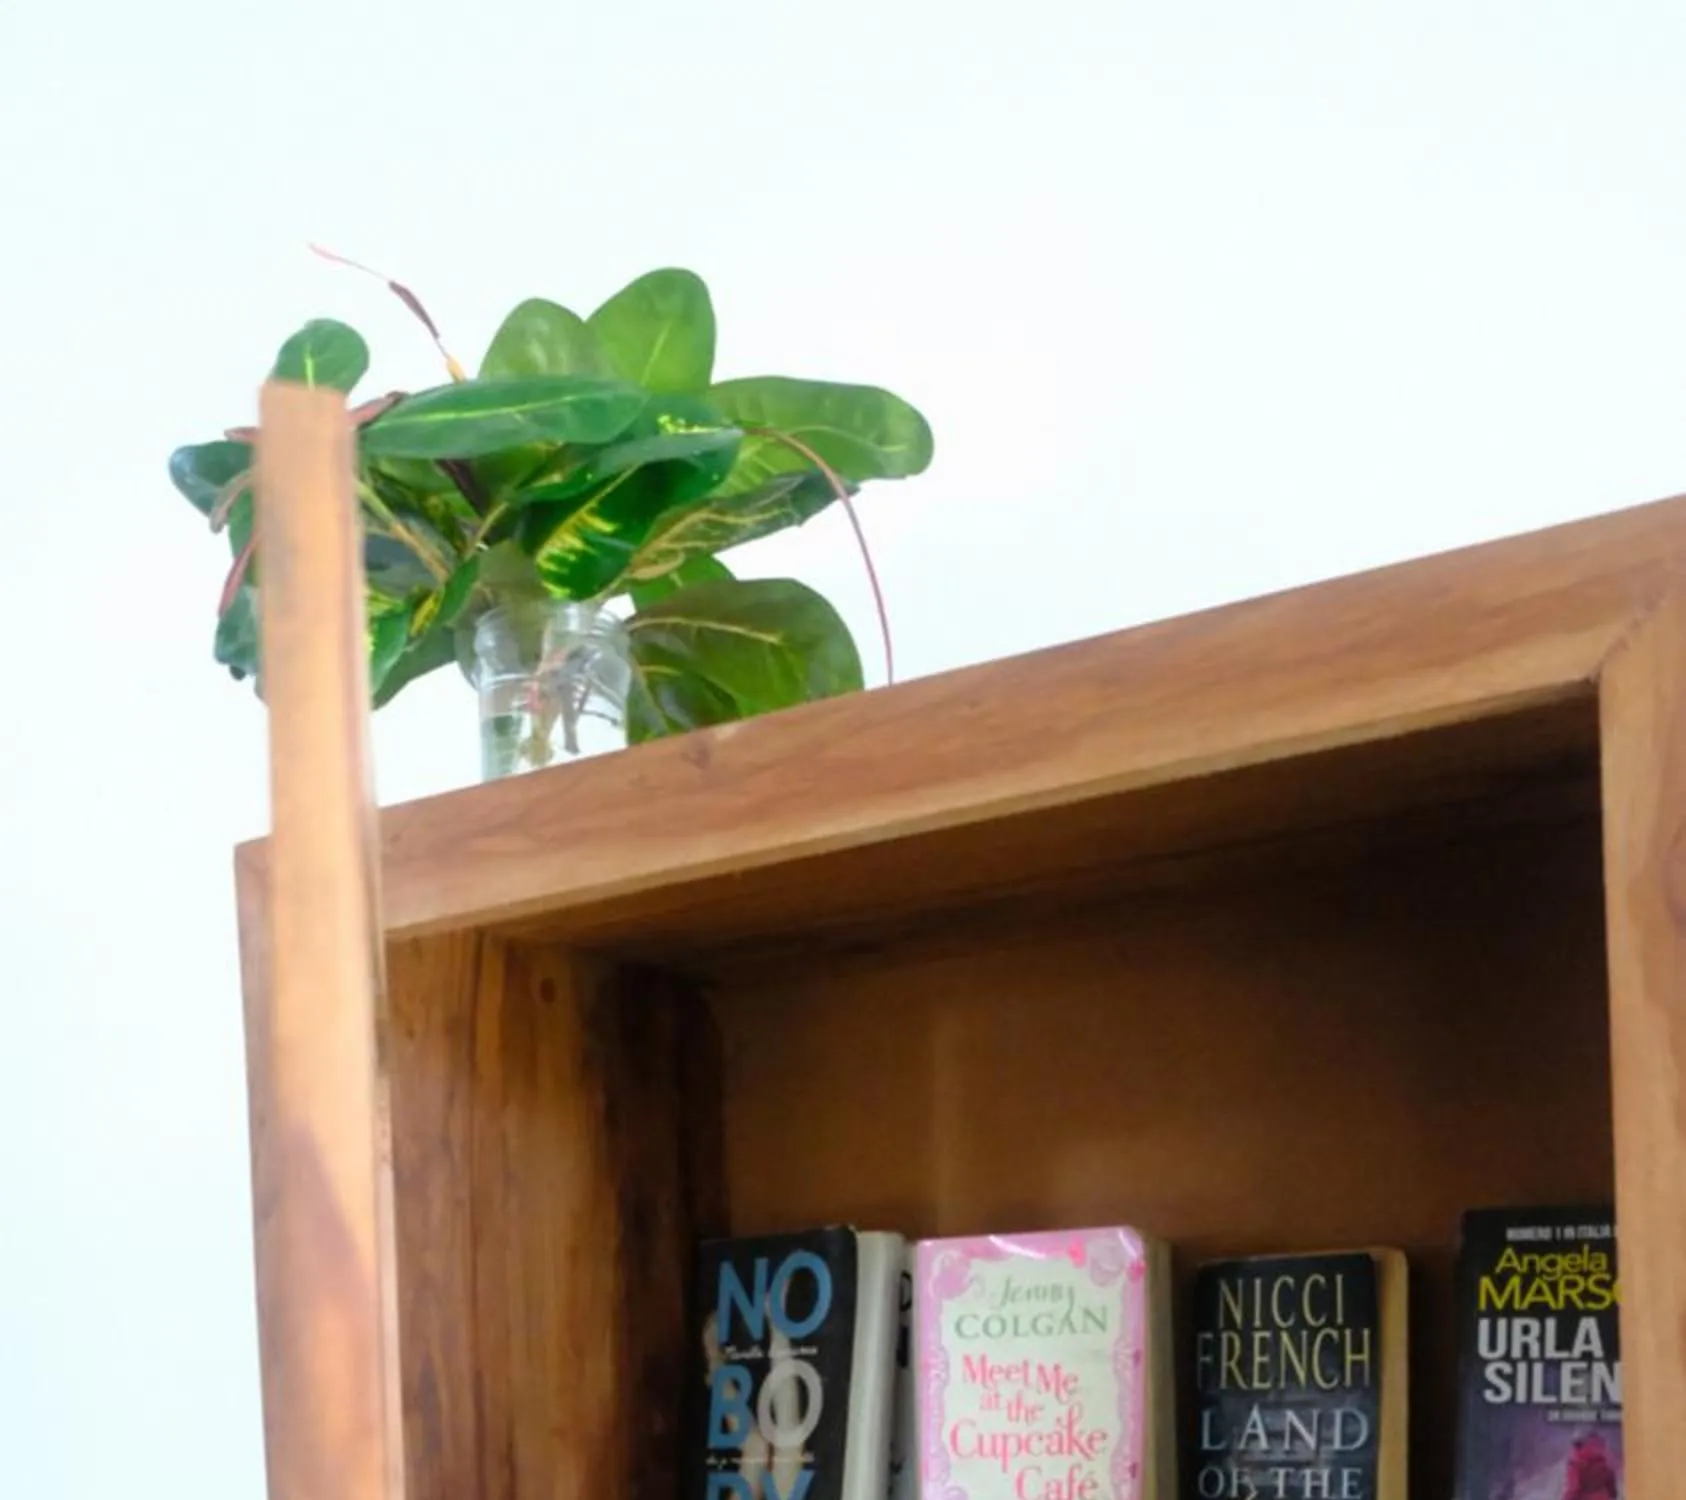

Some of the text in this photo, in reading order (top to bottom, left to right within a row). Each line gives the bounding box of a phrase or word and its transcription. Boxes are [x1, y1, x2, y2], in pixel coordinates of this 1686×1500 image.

[1495, 1244, 1607, 1281] Angela
[716, 1250, 832, 1342] NO
[1218, 1273, 1344, 1329] NICCI
[954, 1306, 1108, 1341] COLGAN
[1478, 1316, 1603, 1360] URLA
[962, 1353, 1079, 1405] Meet Me
[1197, 1328, 1371, 1391] FRENCH
[708, 1359, 823, 1450] BO
[979, 1391, 1045, 1425] at the
[1201, 1403, 1369, 1451] LAND
[949, 1402, 1108, 1474] Cupcake
[1268, 1467, 1363, 1500] THE
